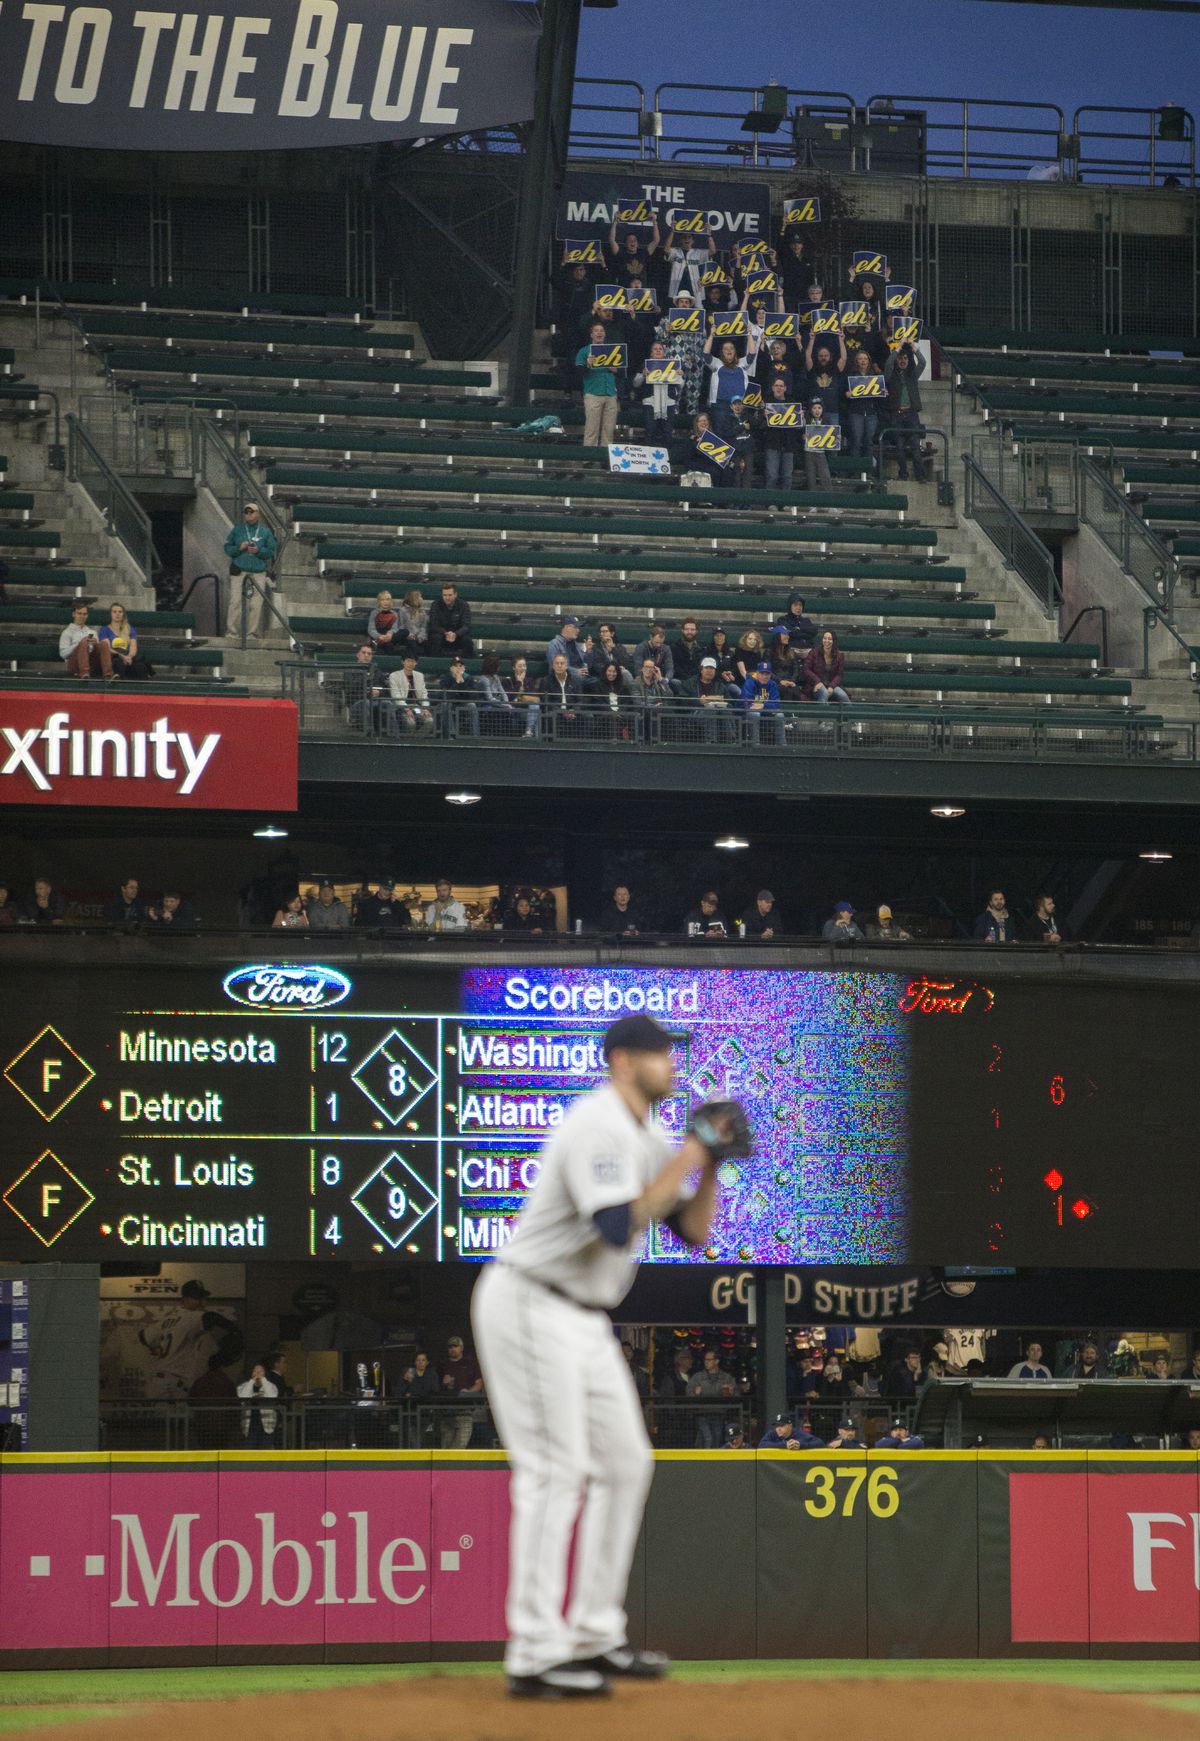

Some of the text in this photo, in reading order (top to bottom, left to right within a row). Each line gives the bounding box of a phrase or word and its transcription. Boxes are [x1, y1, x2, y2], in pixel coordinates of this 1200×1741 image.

[17, 0, 473, 124] TO THE BLUE
[641, 185, 686, 203] THE
[620, 200, 648, 221] eh
[675, 211, 705, 232] eh
[787, 199, 815, 222] eh
[567, 241, 597, 262] eh
[740, 240, 768, 254] eh
[700, 265, 727, 285] eh
[855, 255, 882, 274] eh
[749, 272, 777, 292] eh
[599, 288, 628, 308] eh
[626, 290, 654, 312] eh
[671, 310, 701, 332] eh
[715, 312, 746, 336] eh
[765, 315, 795, 336] eh
[814, 312, 840, 333] eh
[841, 303, 868, 325] eh
[895, 320, 919, 340] eh
[593, 345, 624, 367] eh
[648, 361, 677, 382] eh
[852, 375, 881, 397] eh
[769, 403, 798, 426] eh
[807, 426, 837, 449] eh
[700, 440, 730, 463] eh
[0, 713, 221, 794] xfinity
[248, 969, 325, 1003] Ford
[505, 977, 699, 1012] Scoreboard
[900, 977, 973, 1013] Ford
[119, 1030, 349, 1064] Minnesota 12
[460, 1036, 609, 1074] Washingt
[42, 1060, 62, 1093] F
[389, 1064, 407, 1097] 8
[1050, 1075, 1065, 1105] 6
[119, 1089, 338, 1122] Detroit 1
[461, 1095, 564, 1126] Atlanta
[118, 1153, 341, 1187] St. Louis 8
[461, 1158, 510, 1188] Chi
[42, 1184, 62, 1217] F
[389, 1187, 407, 1219] 9
[118, 1214, 342, 1247] Cincinnati 4
[711, 1272, 919, 1318] GOD STUFF
[961, 1335, 975, 1348] 24
[804, 1466, 899, 1518] 376
